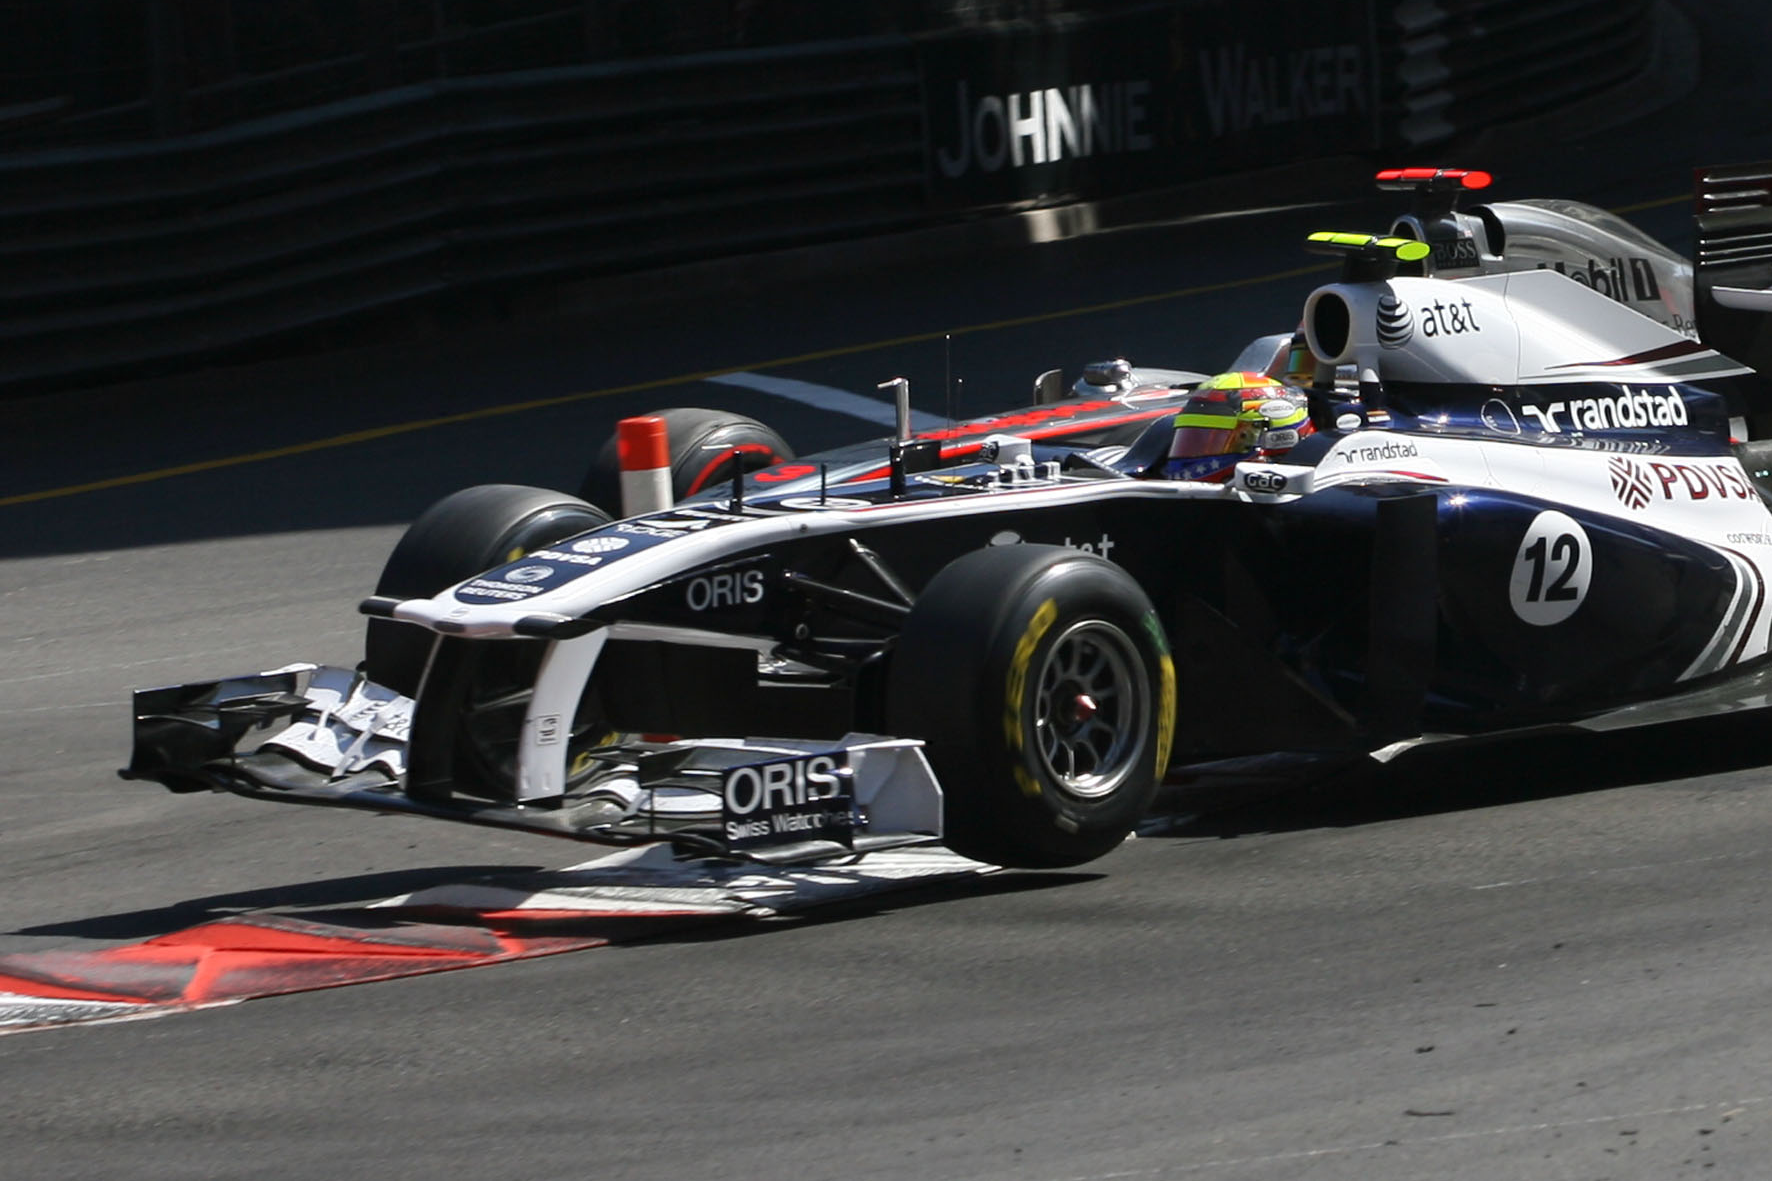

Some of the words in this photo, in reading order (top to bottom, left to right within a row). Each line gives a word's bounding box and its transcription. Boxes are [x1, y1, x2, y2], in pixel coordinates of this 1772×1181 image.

[938, 79, 1154, 180] JOHNNIE
[1200, 42, 1370, 138] WALKER
[1422, 297, 1481, 337] at&t
[1569, 385, 1689, 430] randstad
[1360, 440, 1419, 463] randstad
[1525, 533, 1580, 603] 12
[686, 570, 764, 612] ORIS
[725, 756, 841, 815] ORIS
[725, 819, 771, 841] Swiss
